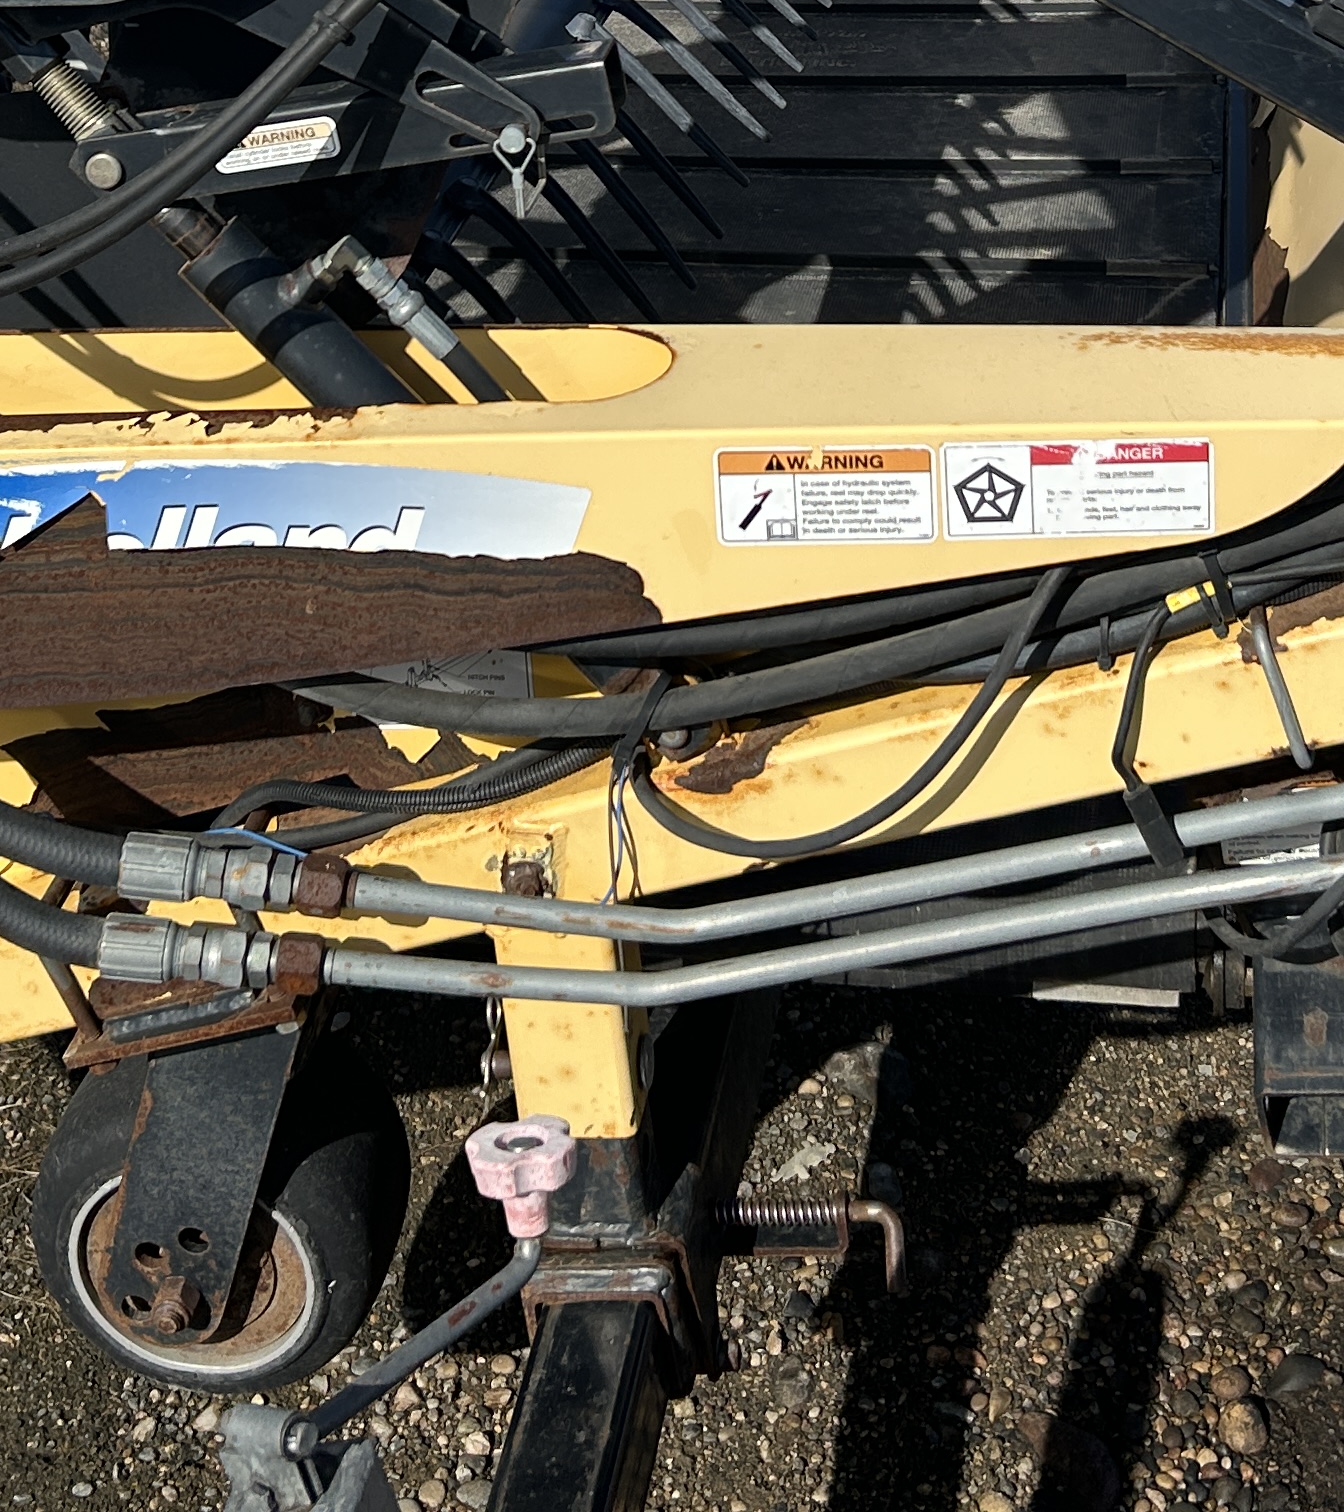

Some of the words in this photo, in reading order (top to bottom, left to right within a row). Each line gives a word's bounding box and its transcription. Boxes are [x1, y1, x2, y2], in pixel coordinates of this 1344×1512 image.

[247, 126, 316, 147] WARNING
[1102, 445, 1164, 461] ANGER
[787, 454, 884, 470] WRNING
